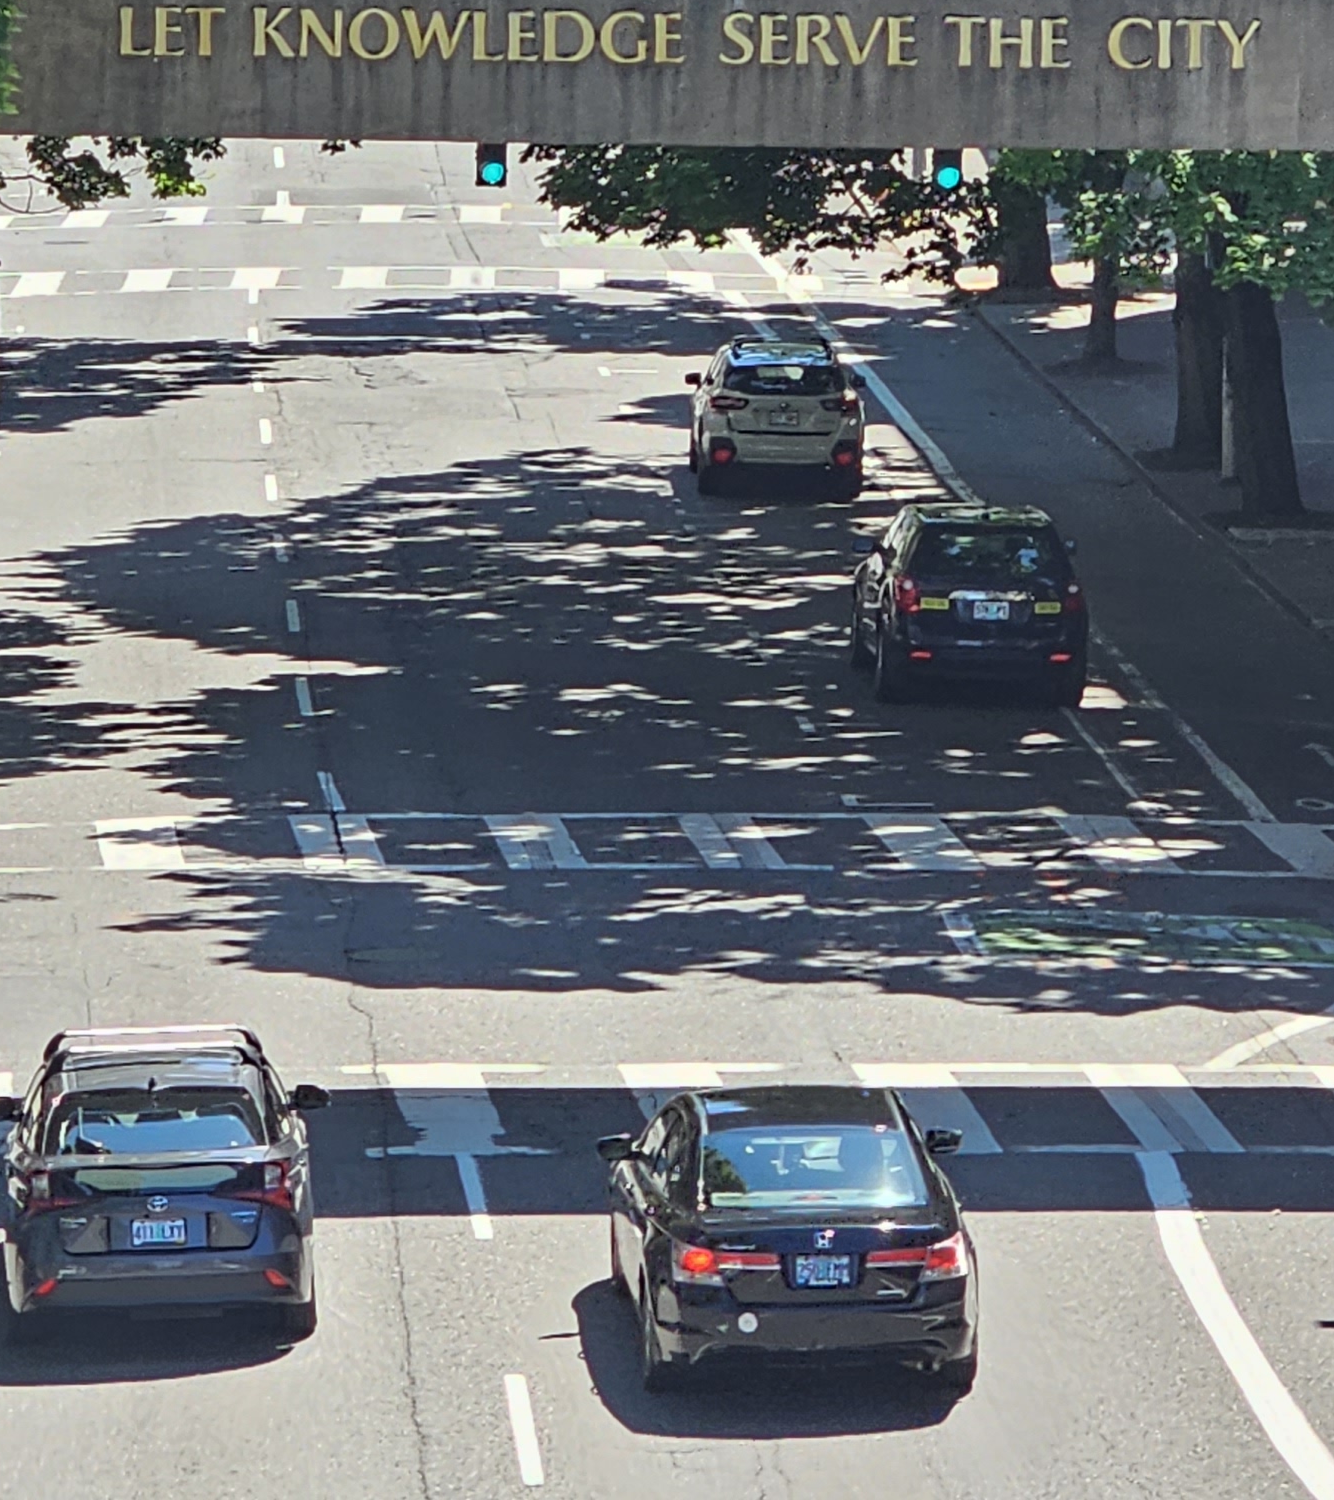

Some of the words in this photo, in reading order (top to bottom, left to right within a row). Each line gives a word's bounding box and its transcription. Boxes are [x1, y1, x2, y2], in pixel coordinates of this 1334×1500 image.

[119, 5, 226, 56] LET
[252, 7, 687, 63] KNOWLEDGE
[719, 12, 918, 66] SERVE
[943, 16, 1072, 68] THE
[1107, 17, 1261, 69] CITY
